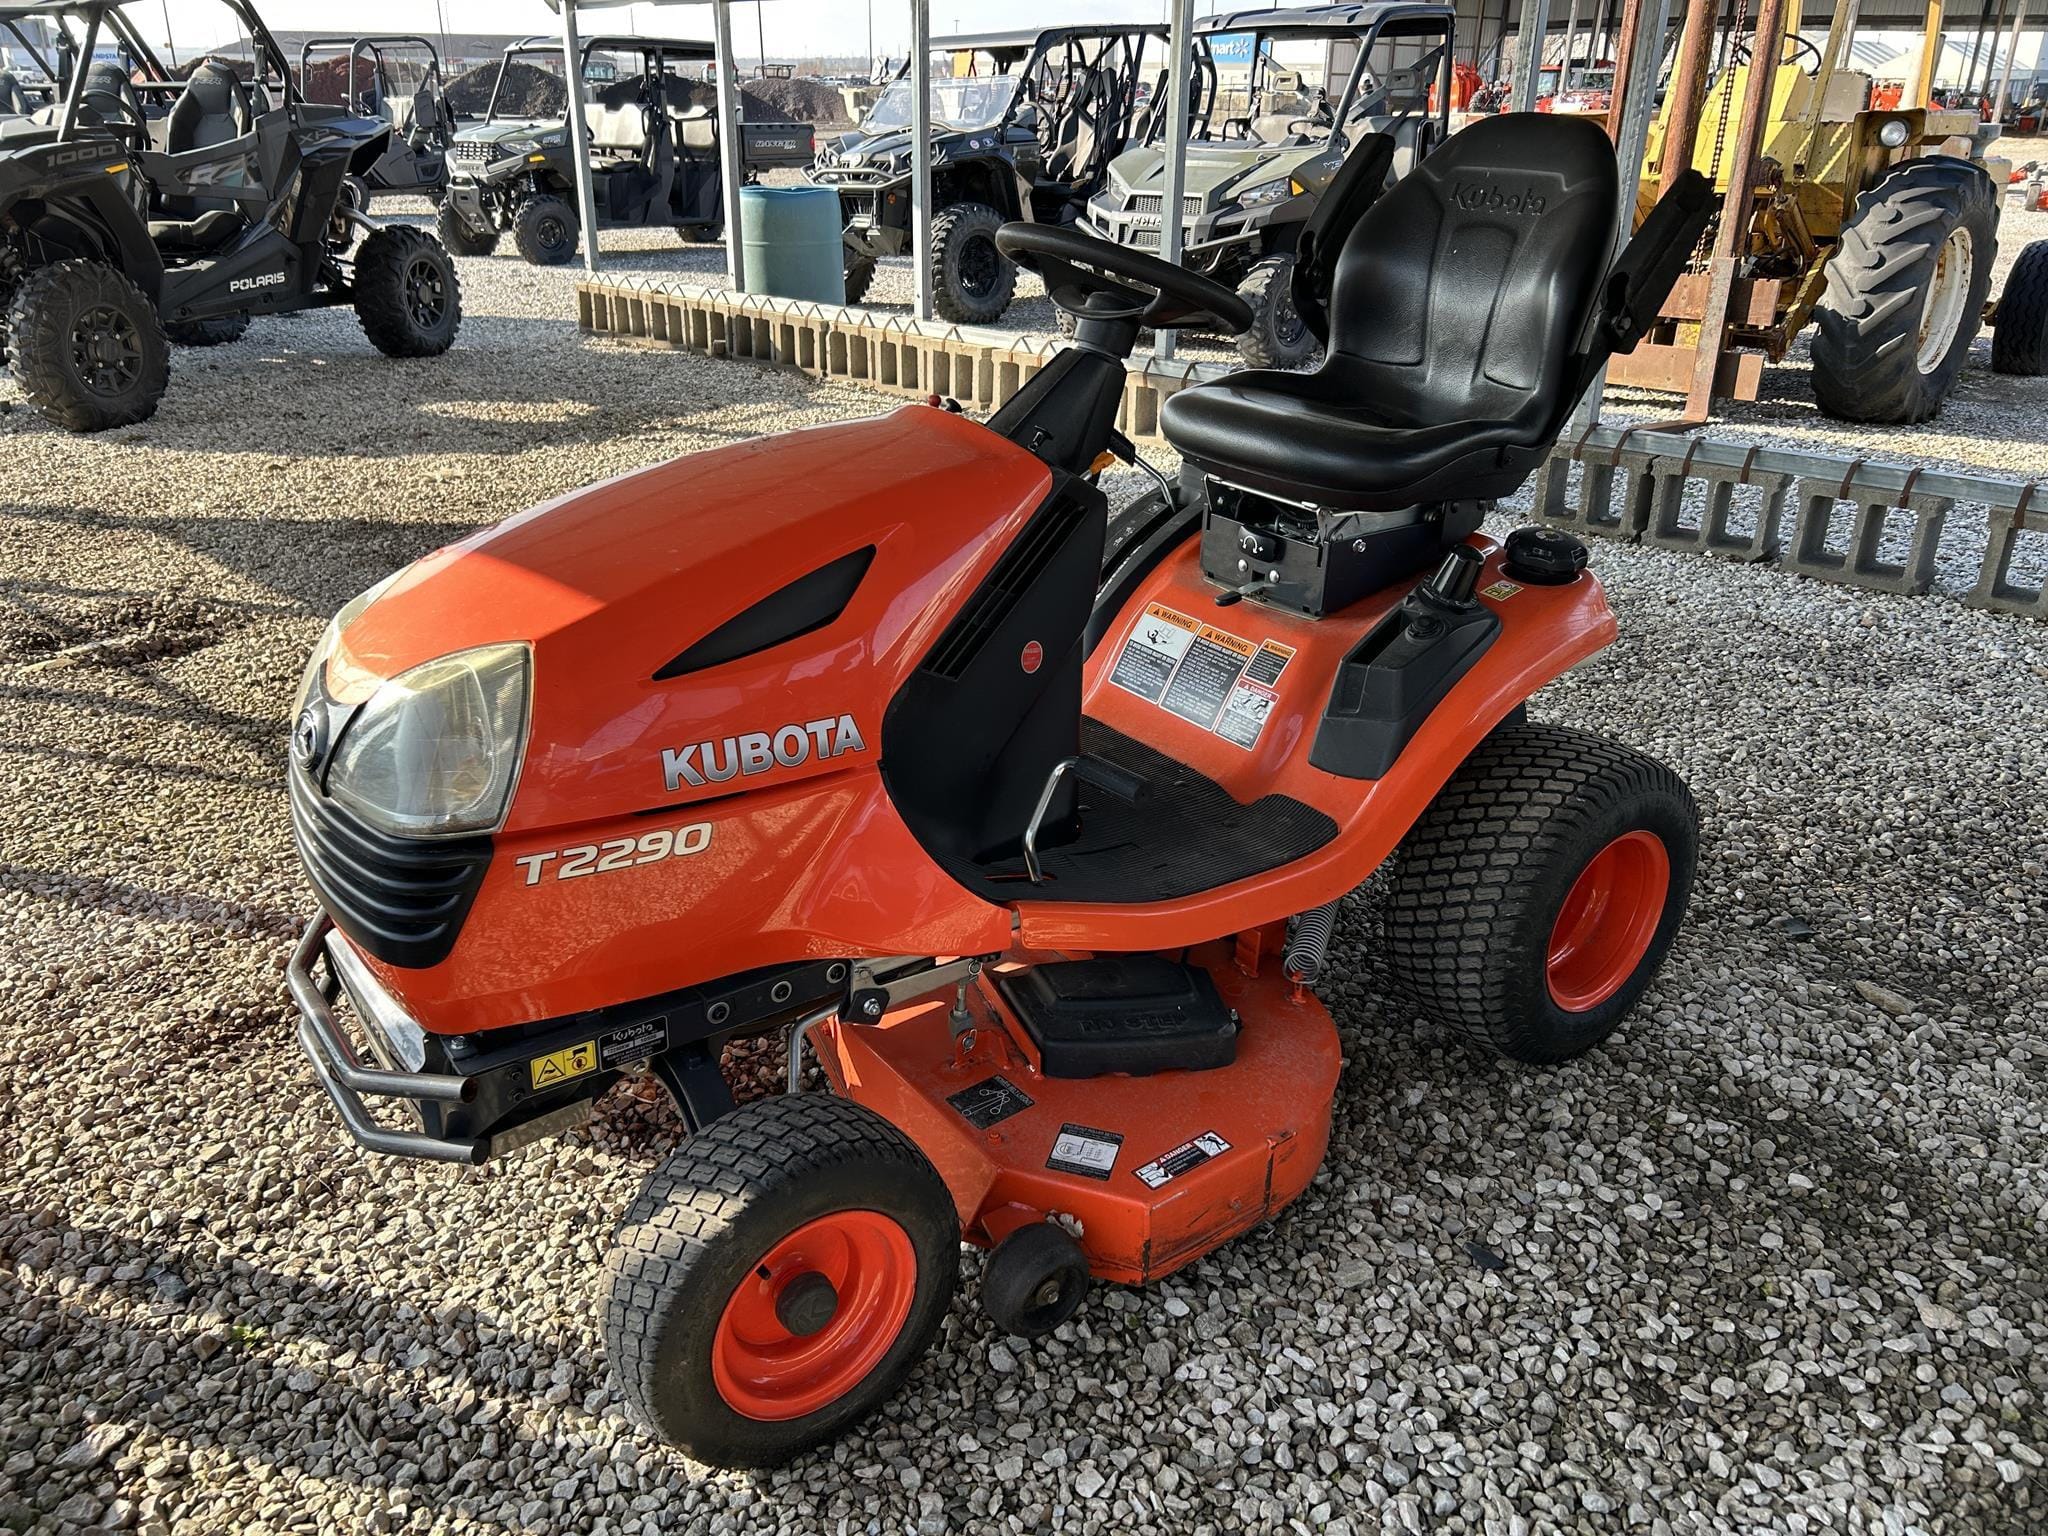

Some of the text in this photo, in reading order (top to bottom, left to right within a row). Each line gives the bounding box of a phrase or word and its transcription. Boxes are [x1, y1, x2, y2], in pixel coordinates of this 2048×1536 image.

[46, 144, 118, 168] 1000
[1449, 183, 1546, 216] Kubota
[230, 271, 285, 293] POLARIS
[1161, 610, 1193, 629] WARNING
[1214, 632, 1249, 653] WARNING
[1249, 685, 1273, 700] DANGER
[660, 714, 866, 792] KUBOTA
[515, 821, 714, 887] T2290
[613, 1024, 653, 1041] Kubota
[1164, 1142, 1194, 1159] DANGER
